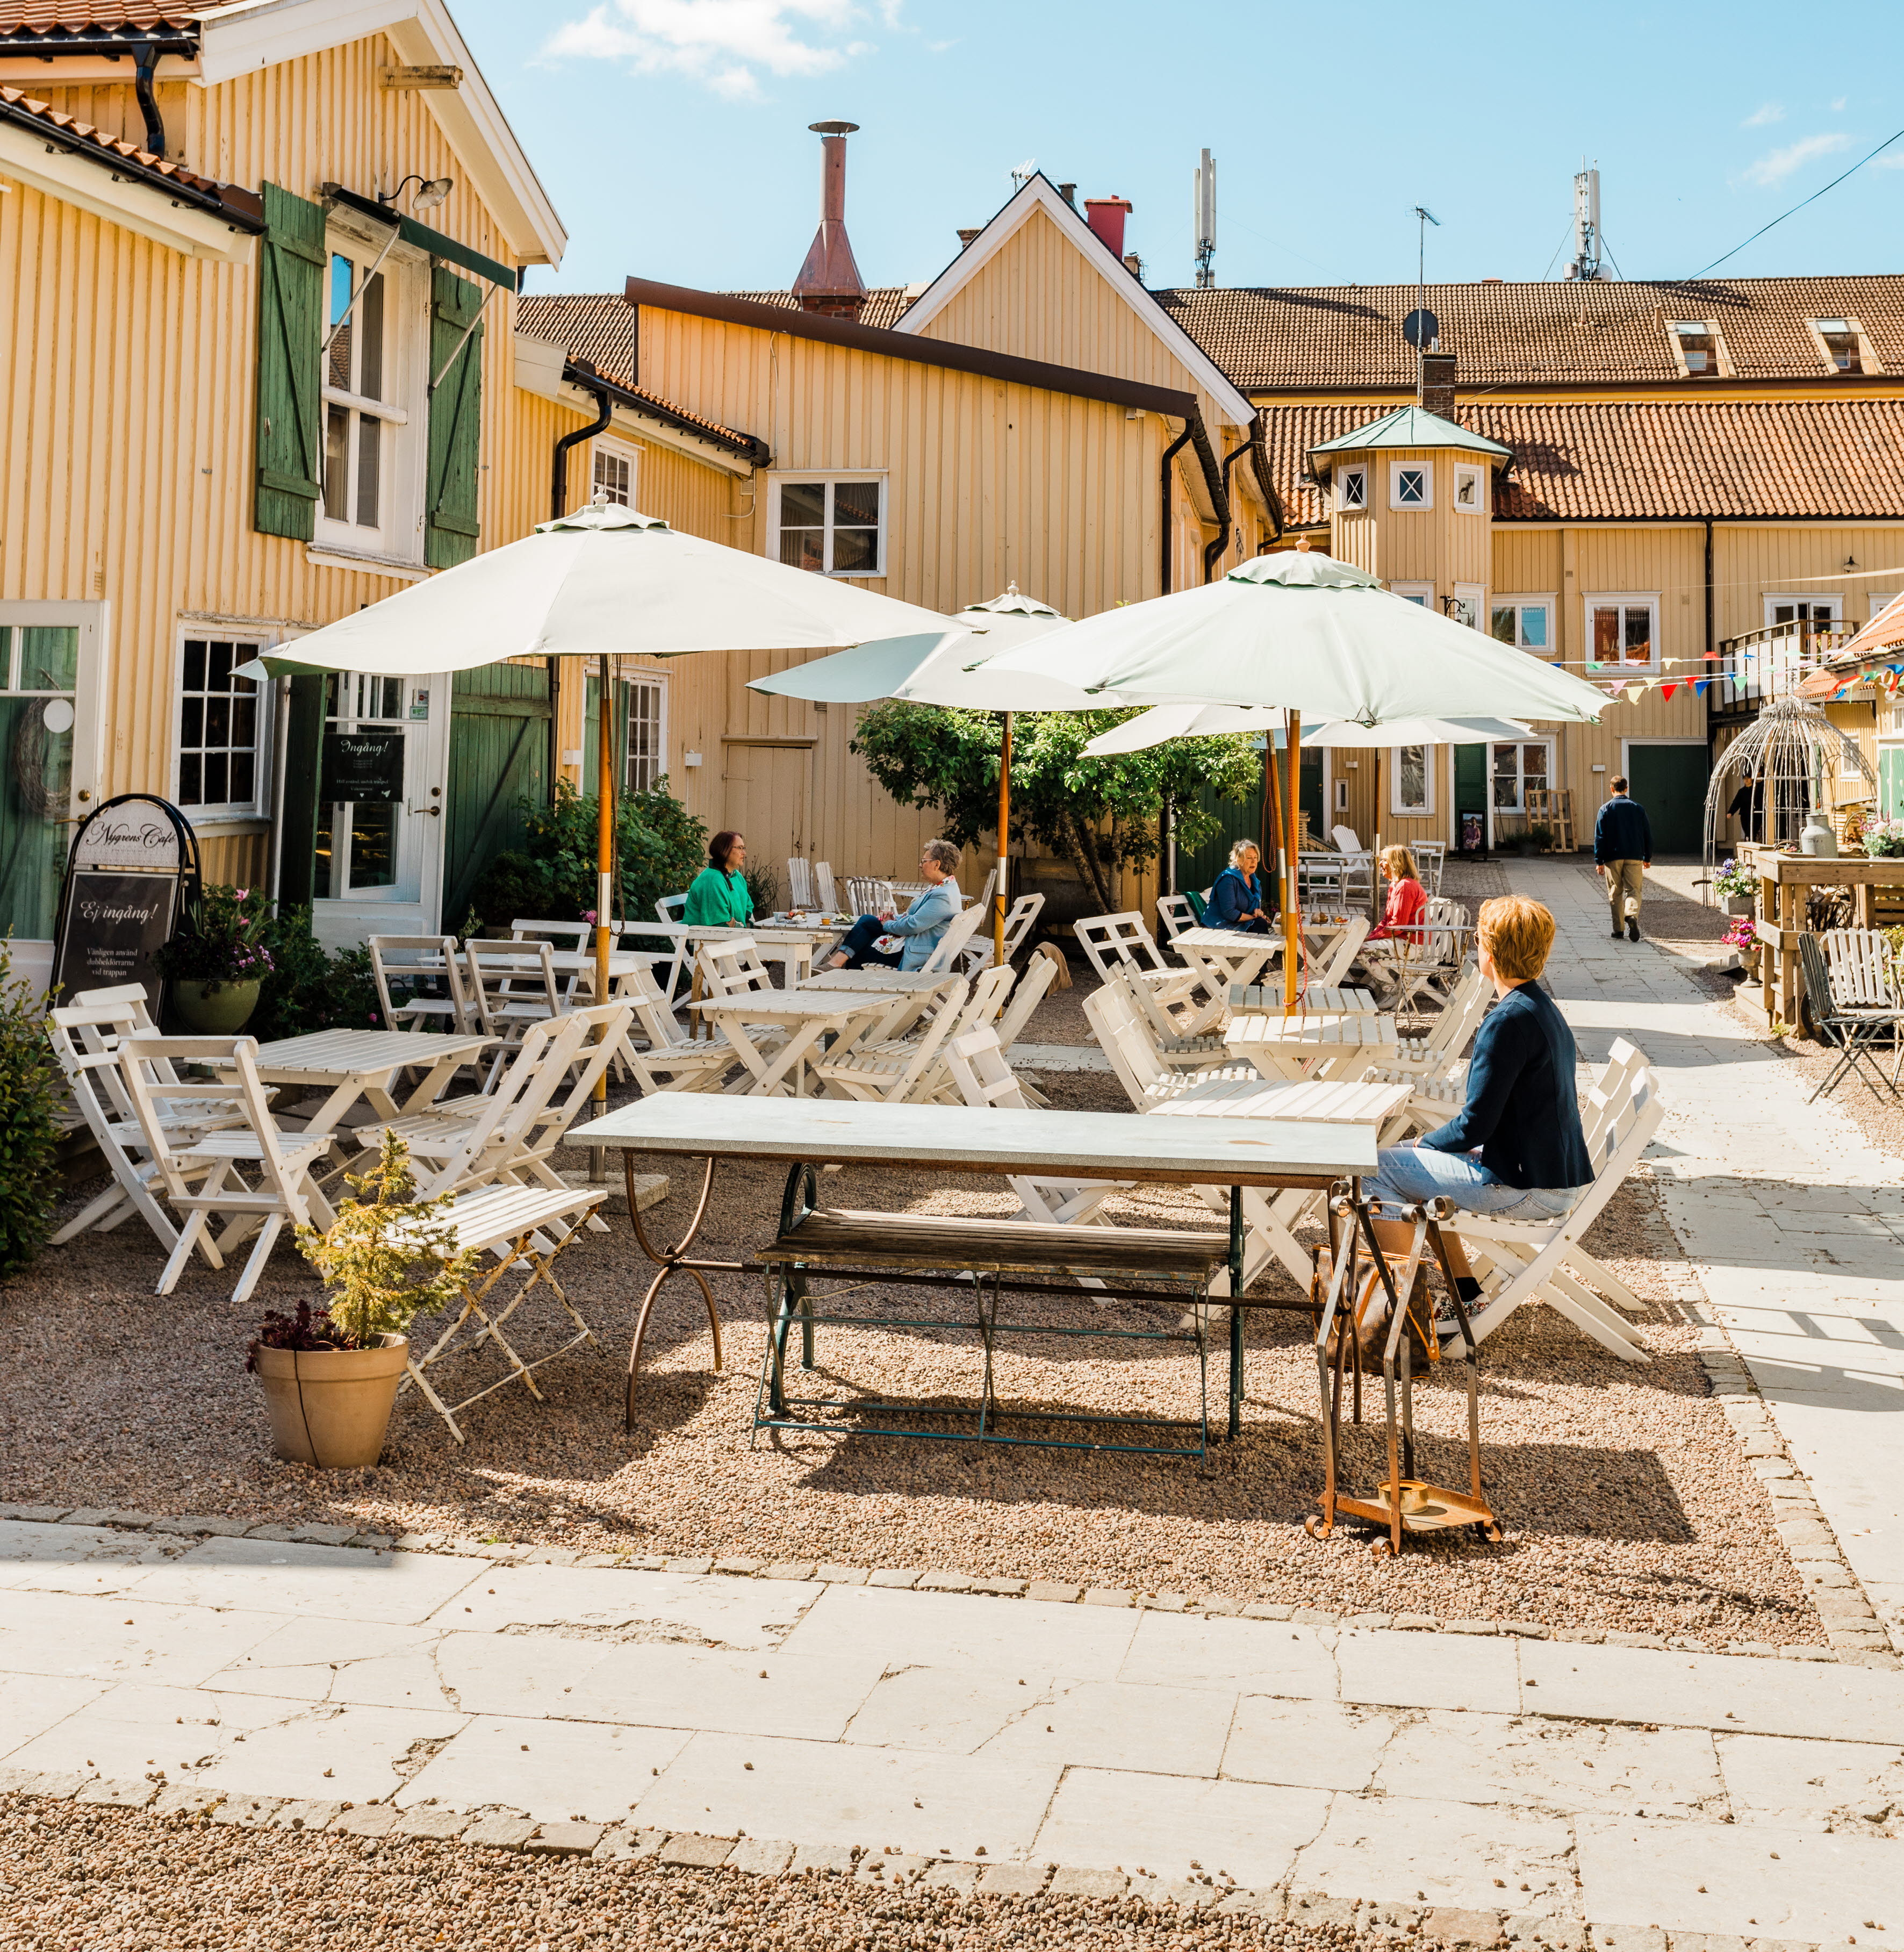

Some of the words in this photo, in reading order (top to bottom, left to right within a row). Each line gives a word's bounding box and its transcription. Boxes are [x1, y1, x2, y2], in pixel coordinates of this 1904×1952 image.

[340, 740, 389, 756] Ingång!
[86, 821, 141, 845] Nygrens
[140, 823, 176, 849] Café
[81, 901, 100, 924] Ej
[103, 903, 159, 925] ingång!
[87, 948, 114, 957] Vänligen
[116, 948, 138, 956] använd
[103, 969, 127, 978] trappan
